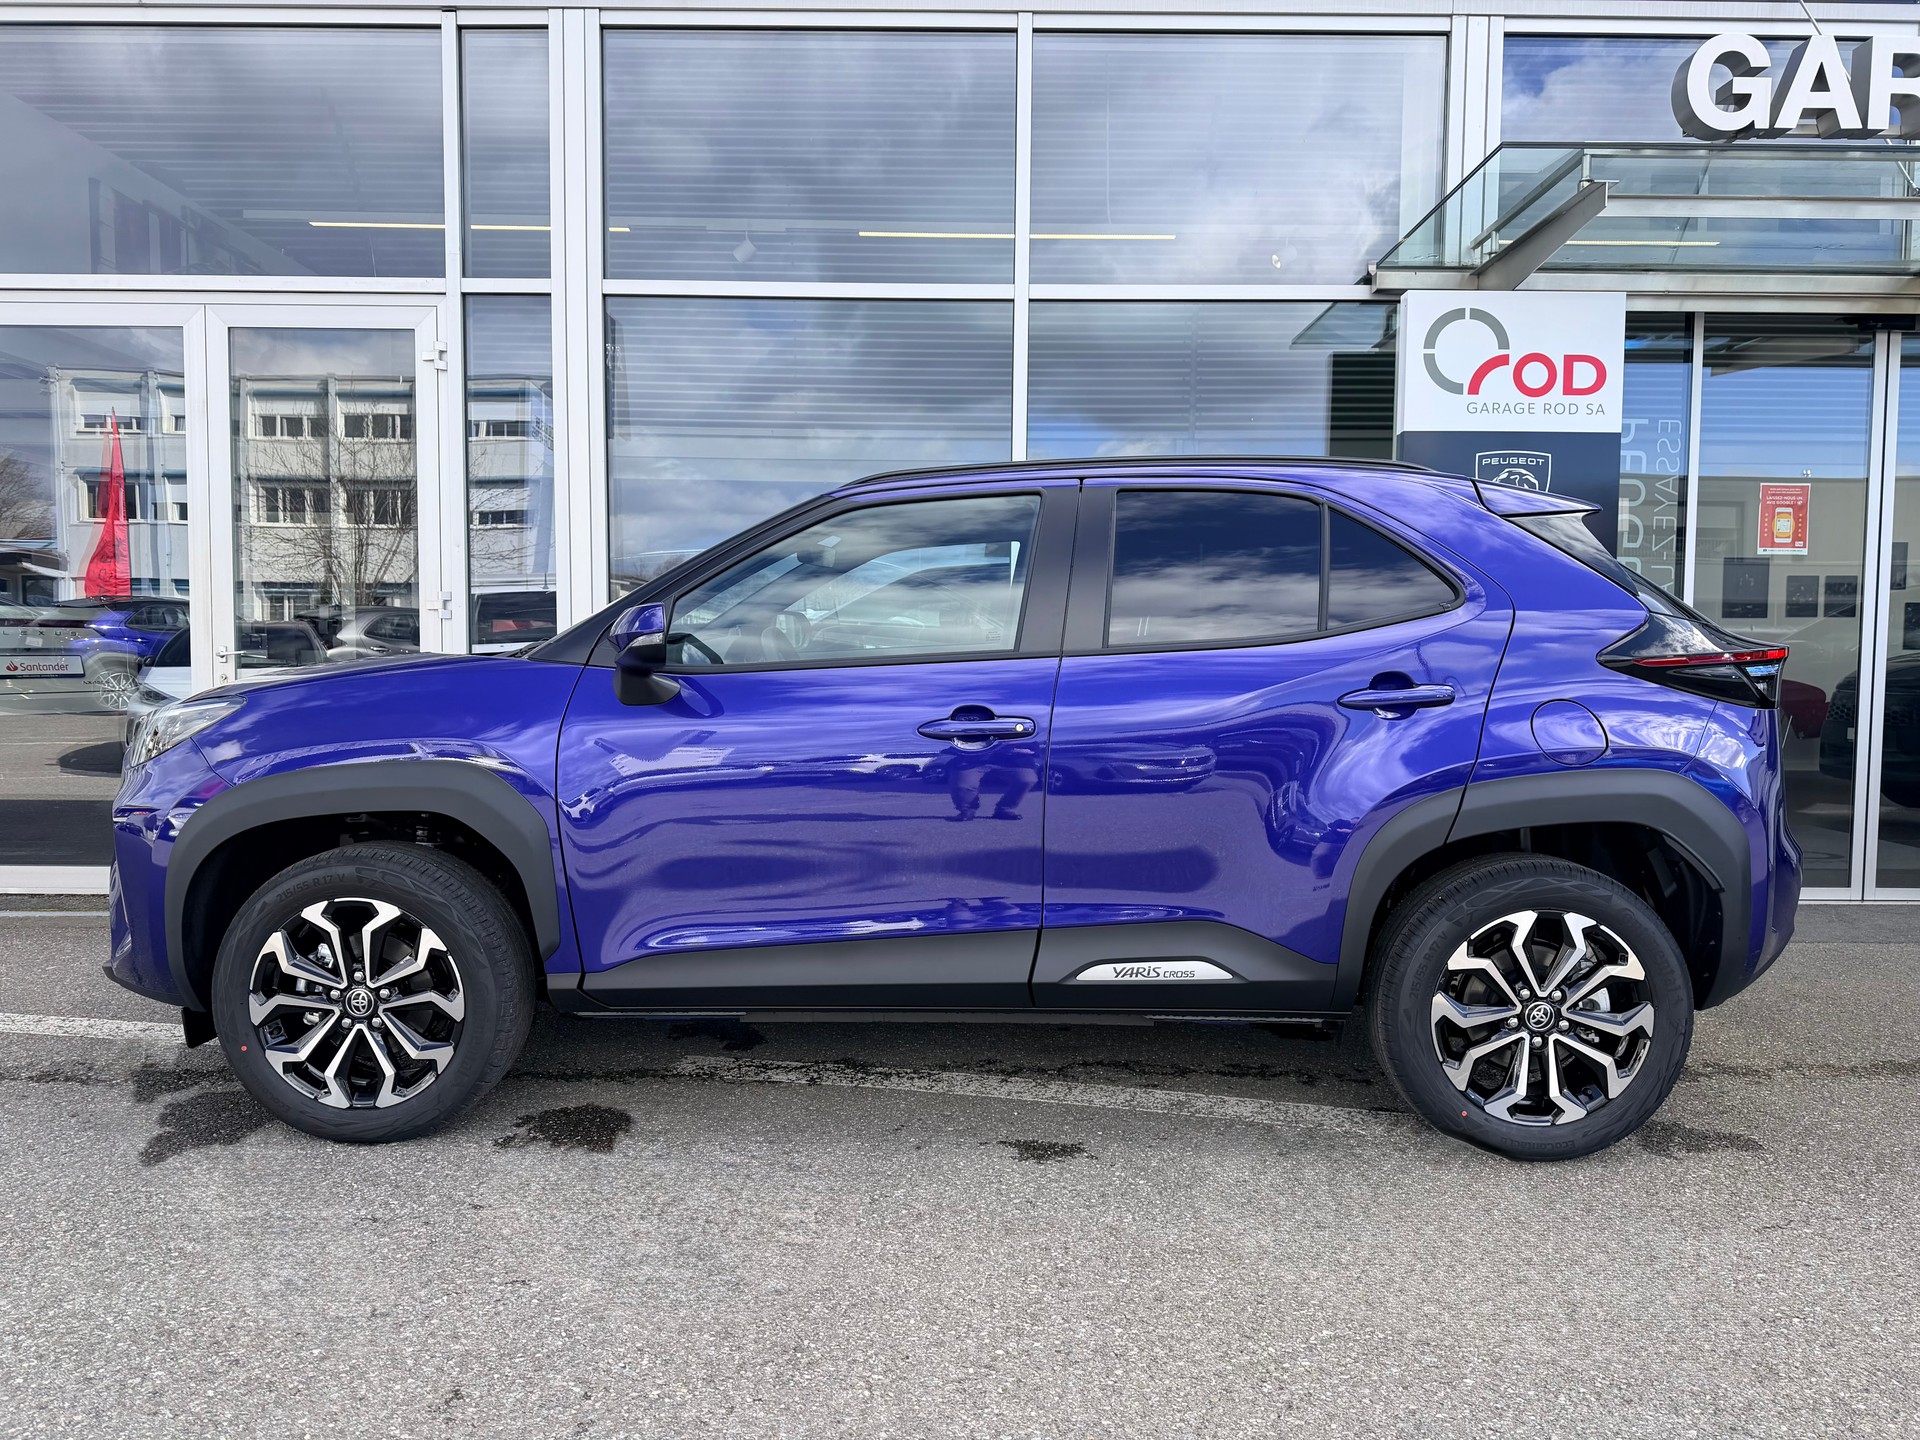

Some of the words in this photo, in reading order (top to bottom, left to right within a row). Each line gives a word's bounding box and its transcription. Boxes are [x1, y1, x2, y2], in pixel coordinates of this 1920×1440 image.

[1466, 402, 1536, 415] GARAGE
[1543, 402, 1579, 415] ROD
[1586, 403, 1606, 416] SA
[1482, 457, 1545, 466] PEUGEOT
[19, 662, 69, 672] Santander
[1163, 970, 1196, 979] CROSS
